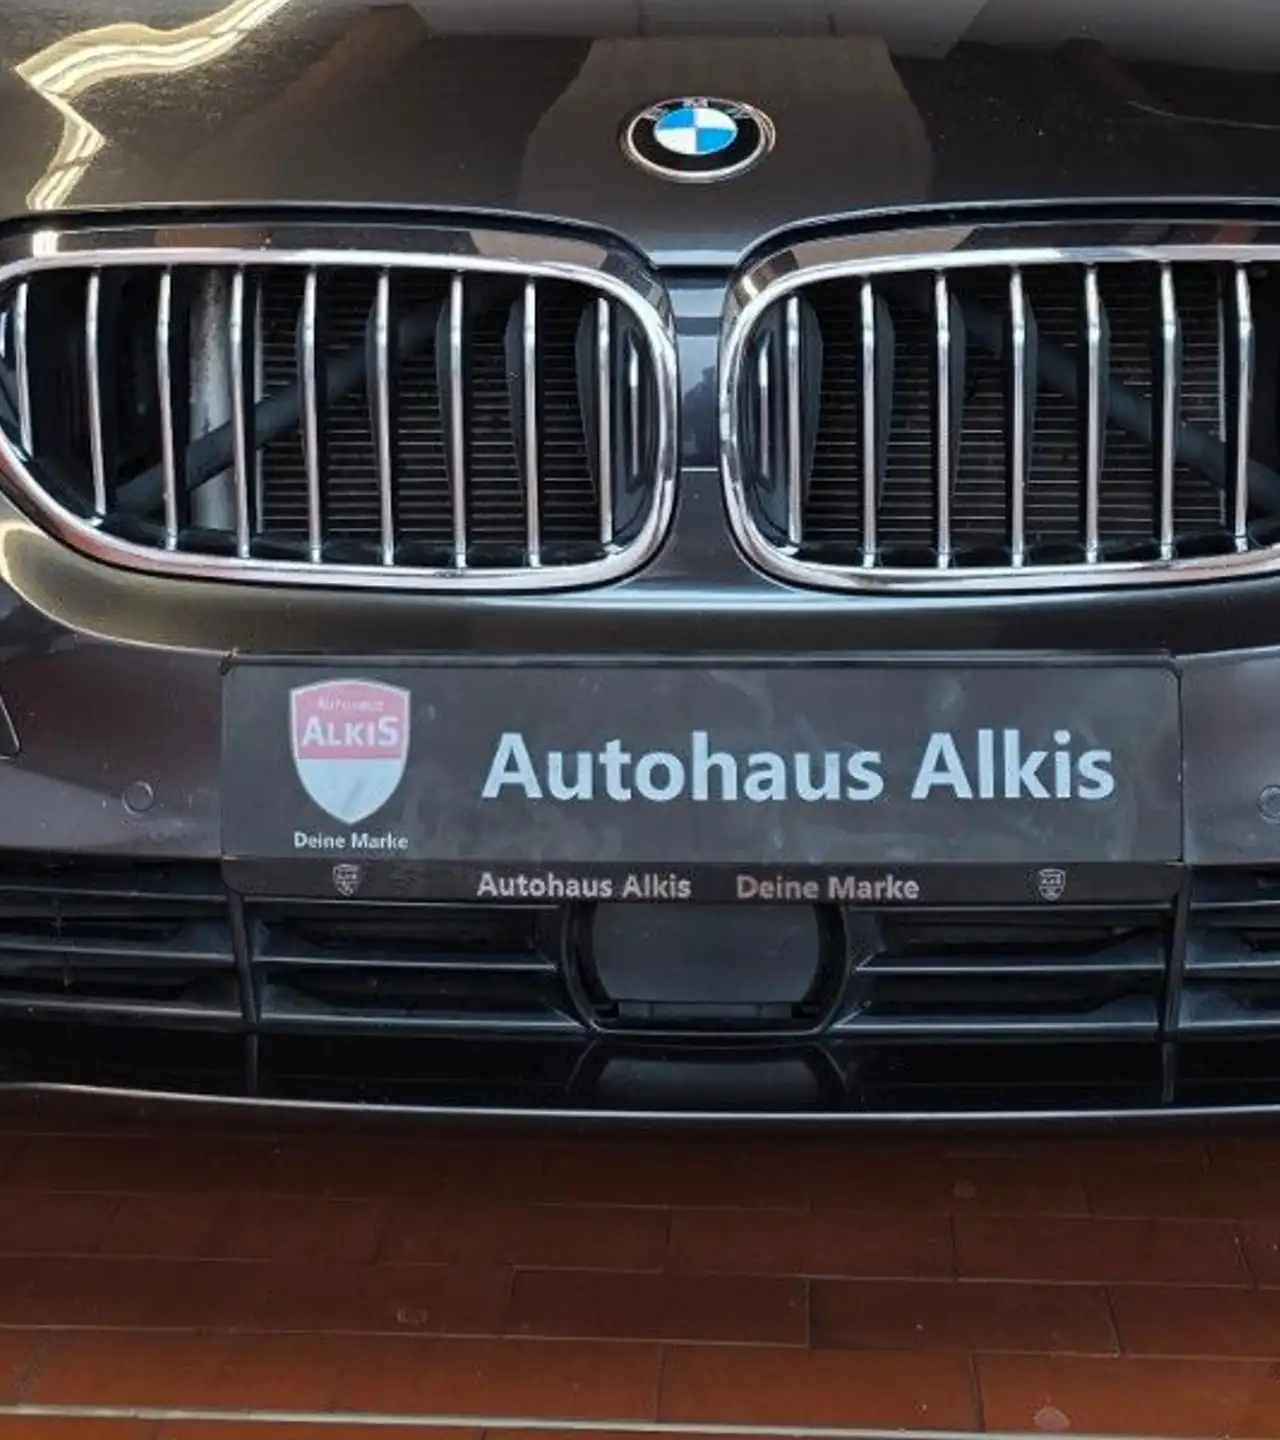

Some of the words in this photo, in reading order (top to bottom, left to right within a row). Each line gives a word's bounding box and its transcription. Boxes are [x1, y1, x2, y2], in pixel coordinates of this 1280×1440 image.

[300, 715, 400, 748] ALKIS
[481, 731, 885, 801] Autohaus
[910, 728, 1116, 800] Alkis
[293, 831, 346, 849] Deine
[351, 831, 409, 850] Marke
[476, 872, 613, 898] Autohaus
[621, 873, 692, 899] Alkis
[736, 875, 819, 900] Deine
[828, 876, 920, 900] Marke
